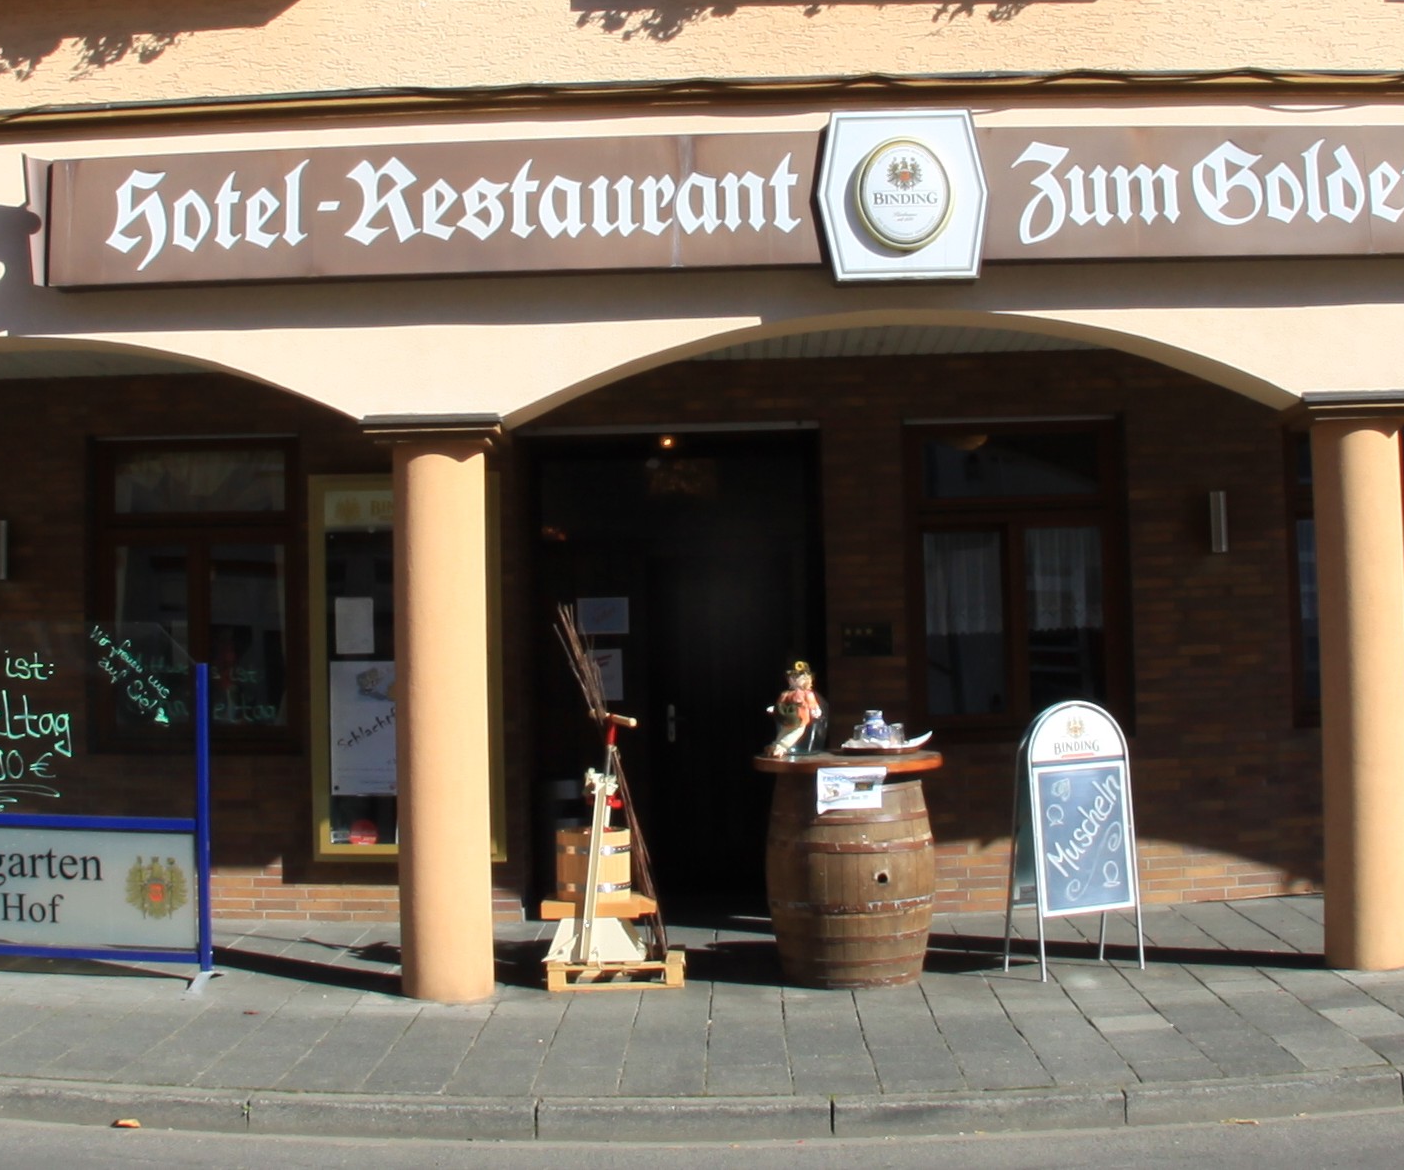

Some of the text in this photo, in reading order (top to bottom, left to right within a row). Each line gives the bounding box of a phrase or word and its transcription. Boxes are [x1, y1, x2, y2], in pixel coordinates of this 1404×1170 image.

[873, 192, 938, 205] BINDING
[1011, 141, 1181, 245] Zum
[1053, 740, 1100, 756] BINDING
[1046, 775, 1121, 878] Muscheln
[0, 892, 64, 924] Hof
